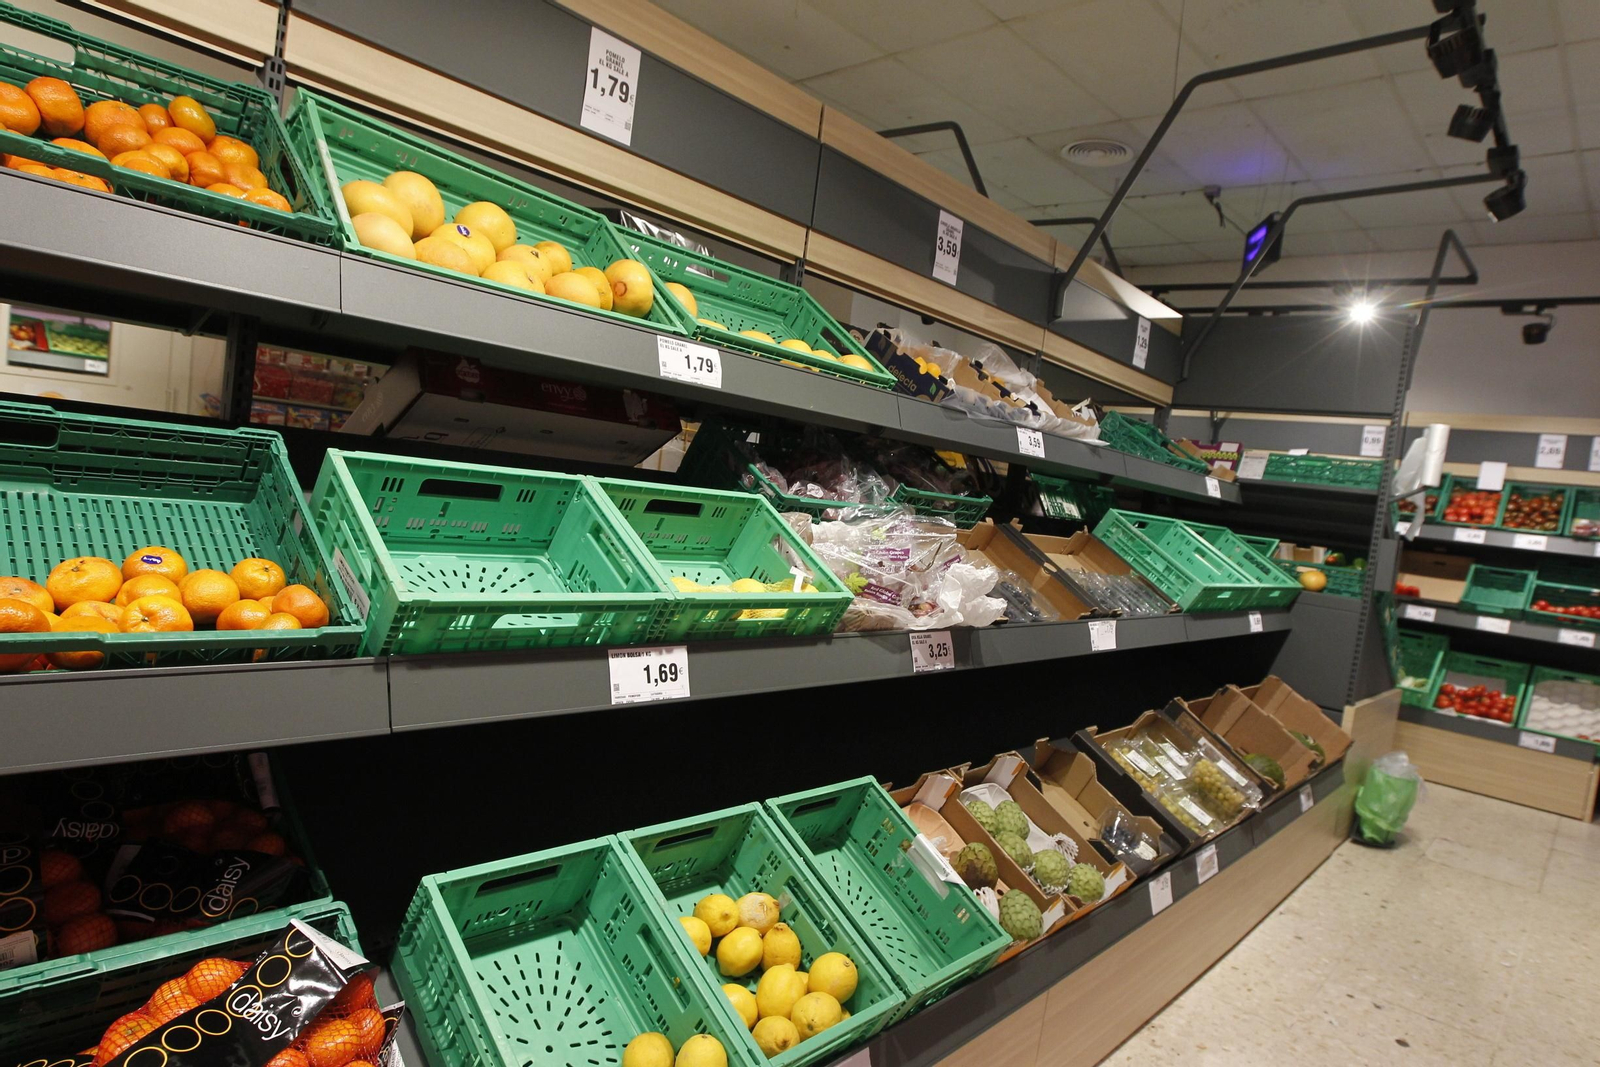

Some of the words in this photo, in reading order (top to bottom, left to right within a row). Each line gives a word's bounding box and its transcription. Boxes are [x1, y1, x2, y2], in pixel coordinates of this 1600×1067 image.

[605, 49, 626, 63] POMELO
[605, 55, 624, 69] GRANEL
[591, 67, 630, 103] 1,79
[938, 236, 958, 258] 3,59
[684, 354, 714, 373] 1,79
[1028, 435, 1041, 449] 3,59
[929, 643, 948, 660] 3,25
[643, 662, 678, 687] 1,69
[52, 817, 113, 839] daisy
[208, 856, 251, 912] daisy
[232, 992, 291, 1041] daisy
